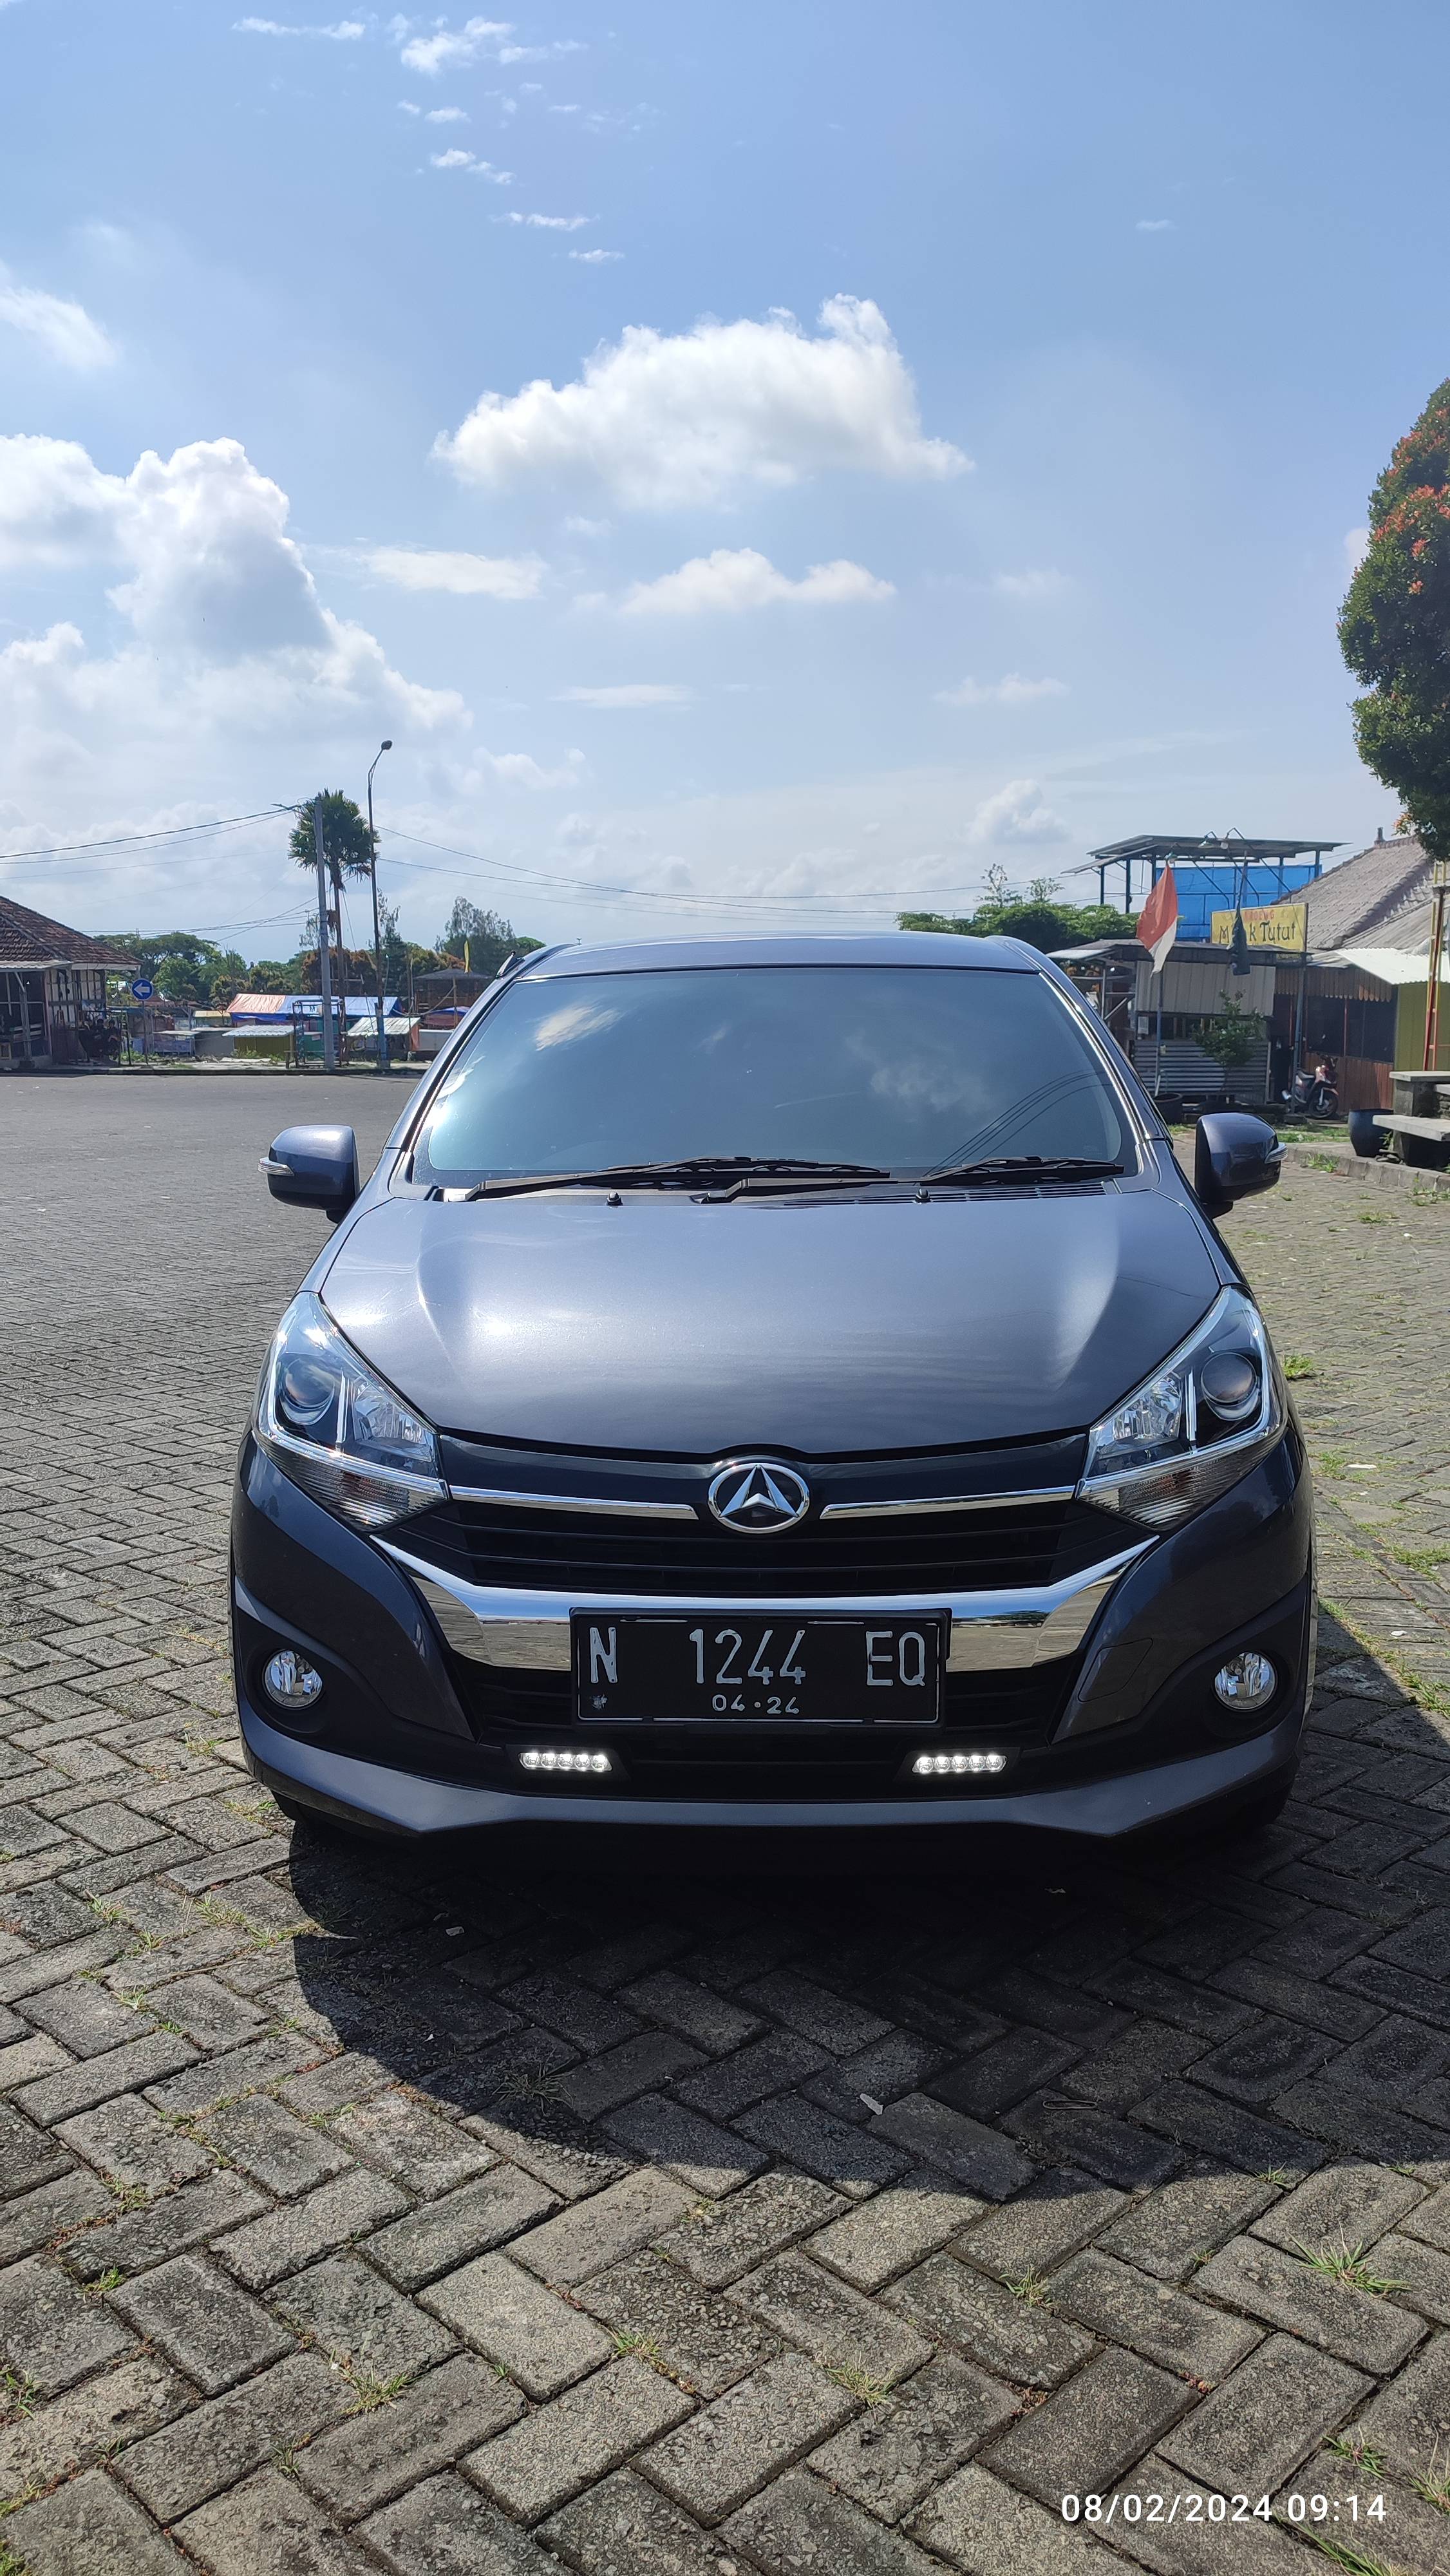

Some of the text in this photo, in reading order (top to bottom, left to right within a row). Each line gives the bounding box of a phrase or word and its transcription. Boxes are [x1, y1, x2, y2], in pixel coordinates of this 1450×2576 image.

[589, 1626, 926, 1687] N 1244 EQ
